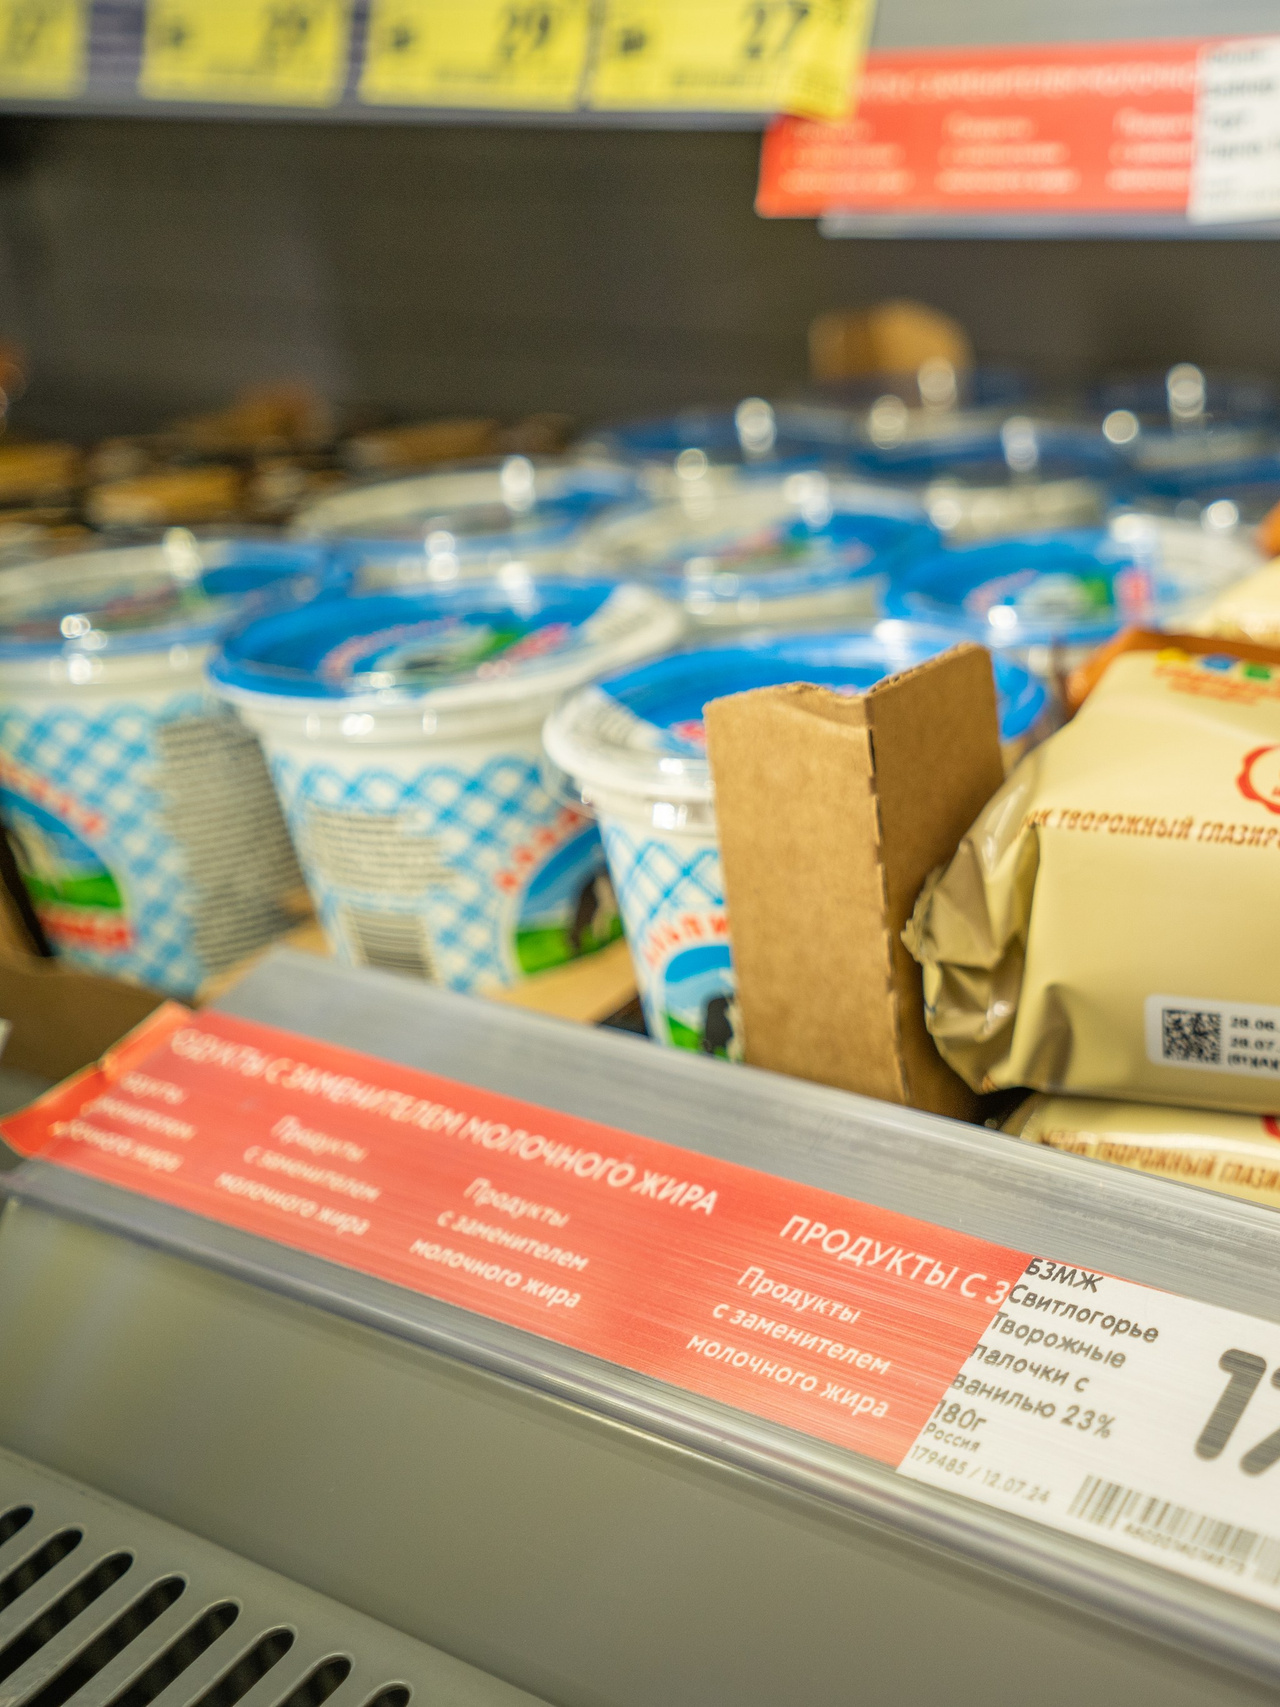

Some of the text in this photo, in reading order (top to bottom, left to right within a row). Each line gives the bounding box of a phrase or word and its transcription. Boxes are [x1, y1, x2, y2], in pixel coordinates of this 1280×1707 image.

[1057, 809, 1194, 841] ТВОРОЖНЫЙ
[457, 1115, 636, 1188] МОЛОЧНОГО
[630, 1168, 718, 1216] ЖИРА
[463, 1177, 570, 1228] Продукты
[436, 1210, 589, 1272] с заменителем
[779, 1214, 959, 1291] ПРОДУКТЫ
[960, 1271, 988, 1299] С
[409, 1238, 581, 1309] молочного жира
[737, 1266, 863, 1325] Продукты
[1025, 1257, 1104, 1294] БЗМЖ
[711, 1303, 892, 1376] с заменителем
[991, 1311, 1127, 1369] Творожные
[1007, 1284, 1160, 1343] Свитлогорье
[685, 1334, 889, 1418] молочного жира
[967, 1343, 1090, 1393] палочки с
[932, 1399, 987, 1433] 180г
[952, 1373, 1117, 1440] ванилью 23%
[910, 1445, 967, 1477] 179485
[923, 1422, 982, 1453] Россия
